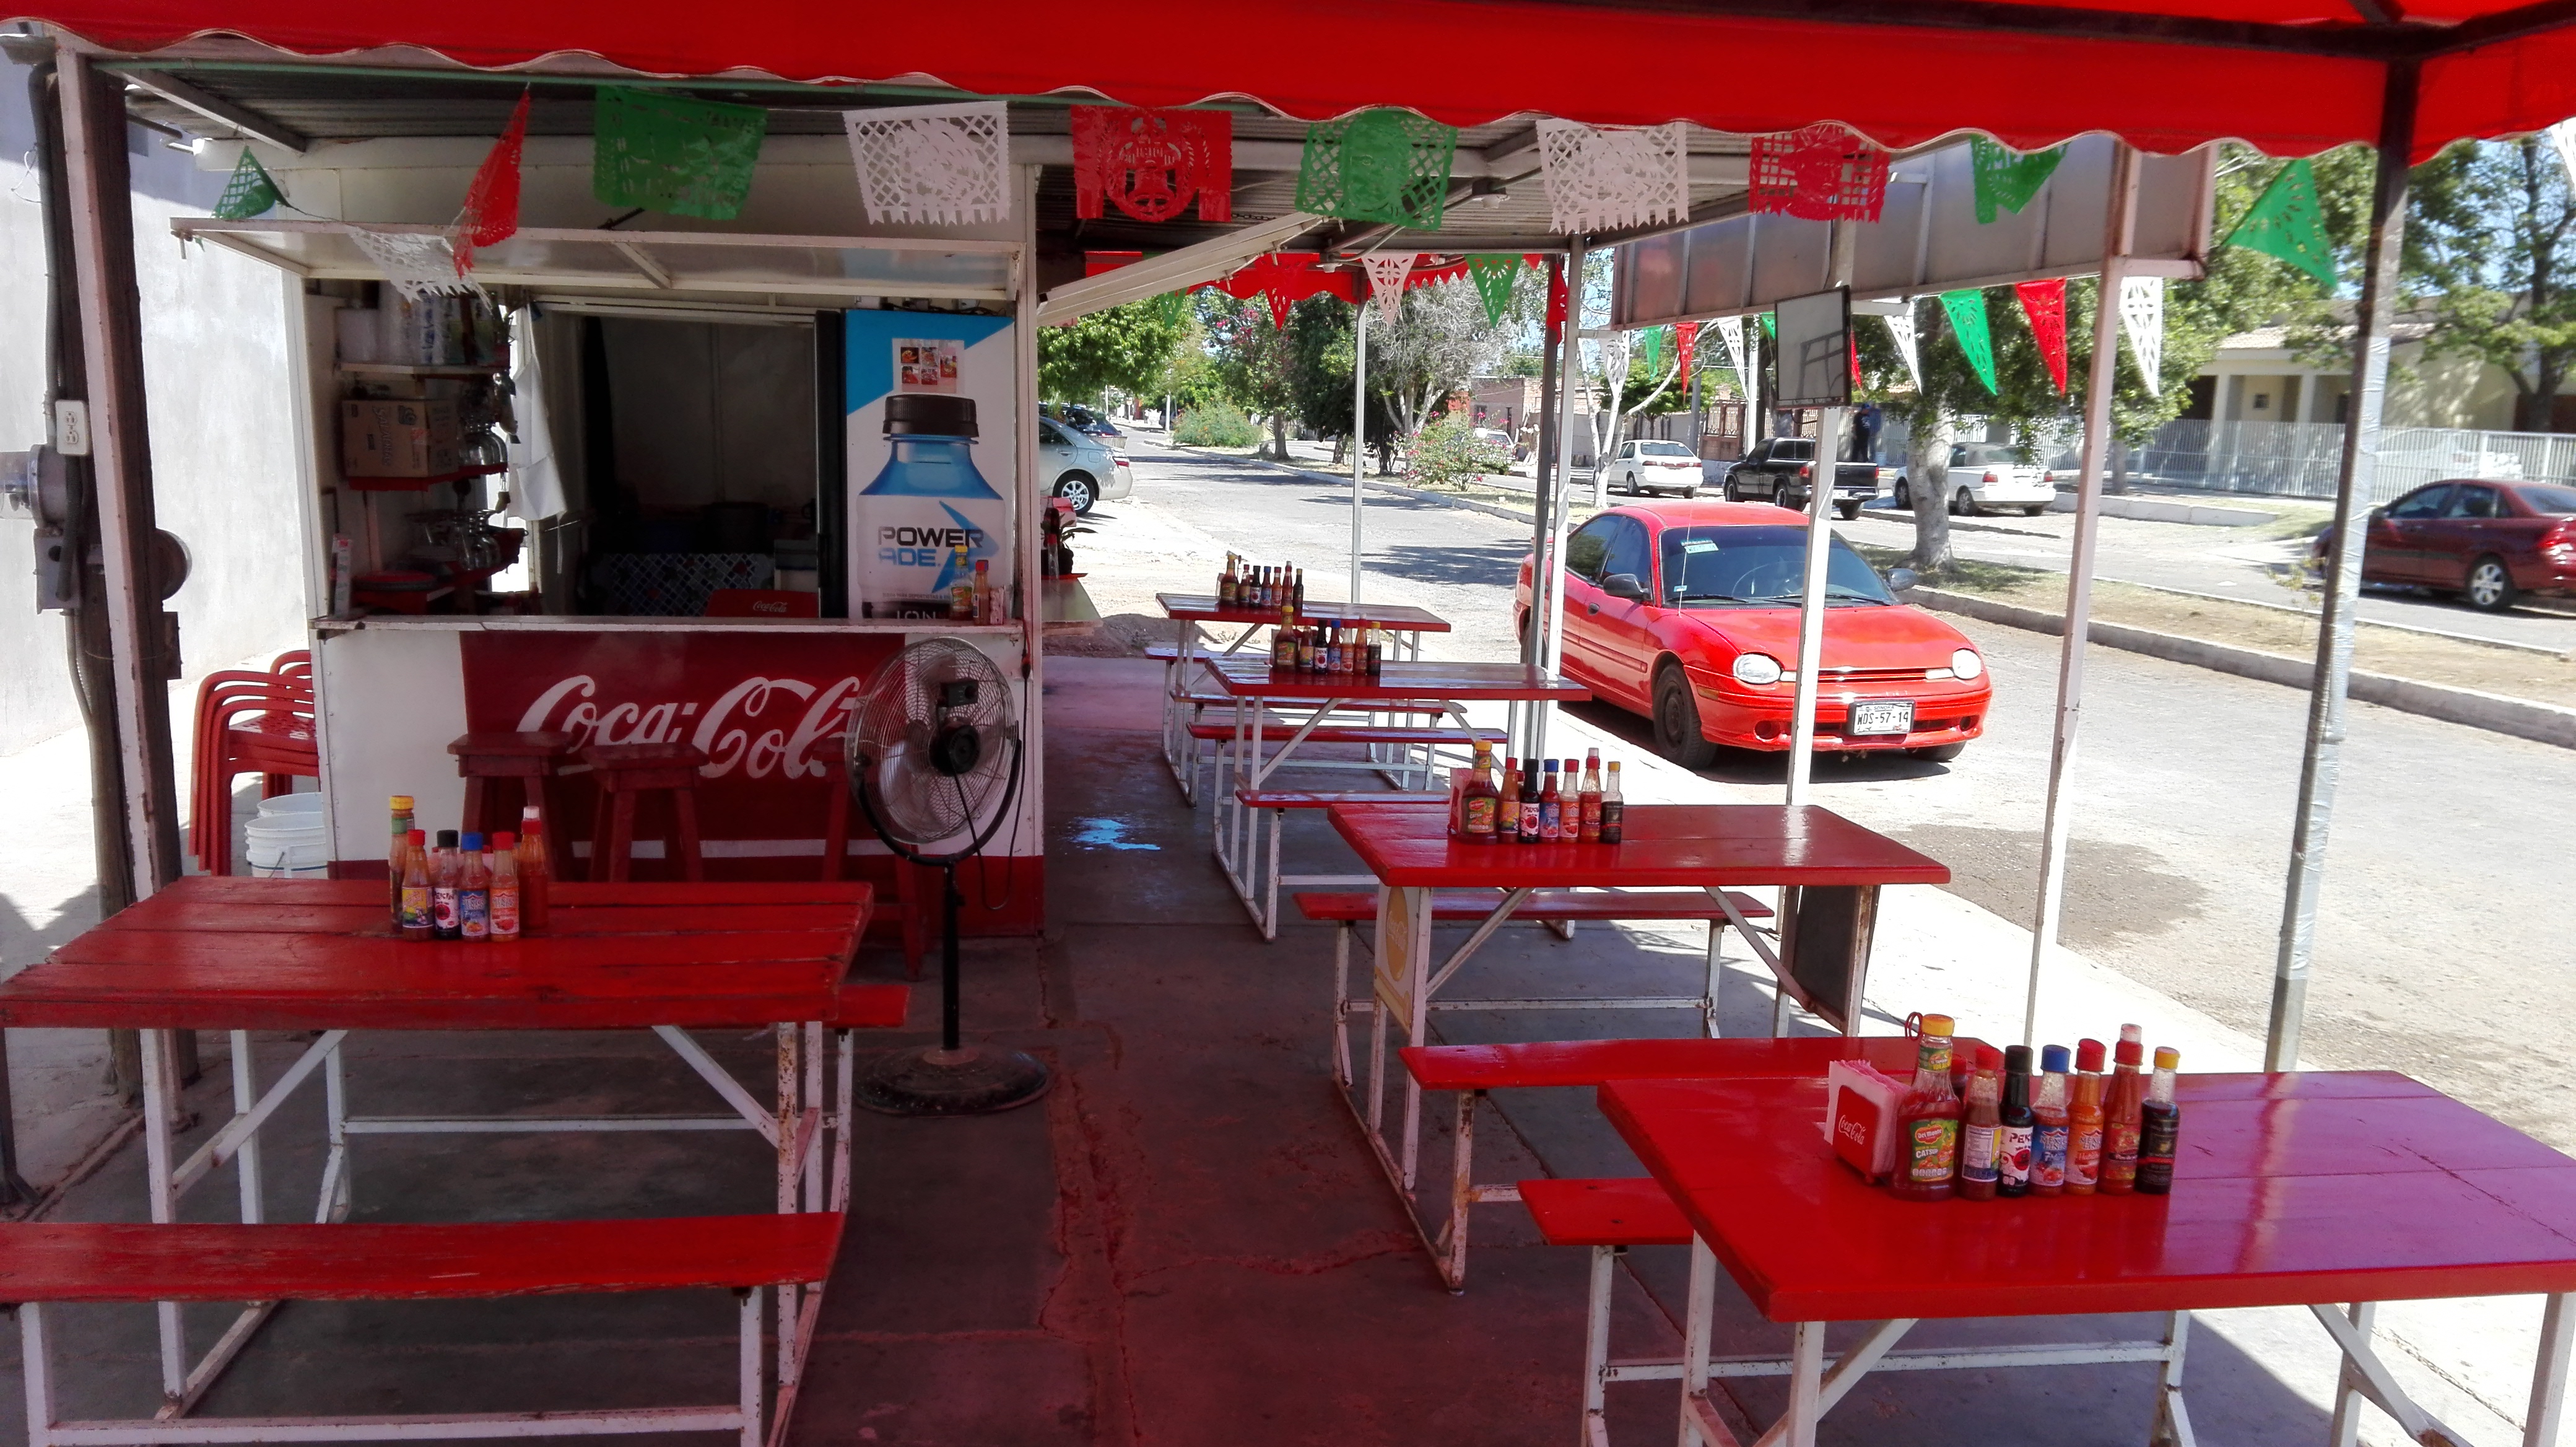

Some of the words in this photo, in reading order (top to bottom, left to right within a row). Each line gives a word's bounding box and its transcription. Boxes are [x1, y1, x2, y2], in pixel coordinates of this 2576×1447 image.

[878, 527, 985, 548] POWER
[753, 601, 787, 613] Coca-Cola
[1857, 712, 1909, 725] WDS-57-14
[1838, 1114, 1866, 1145] Coca-Cola
[1915, 1148, 1939, 1158] CATSUP
